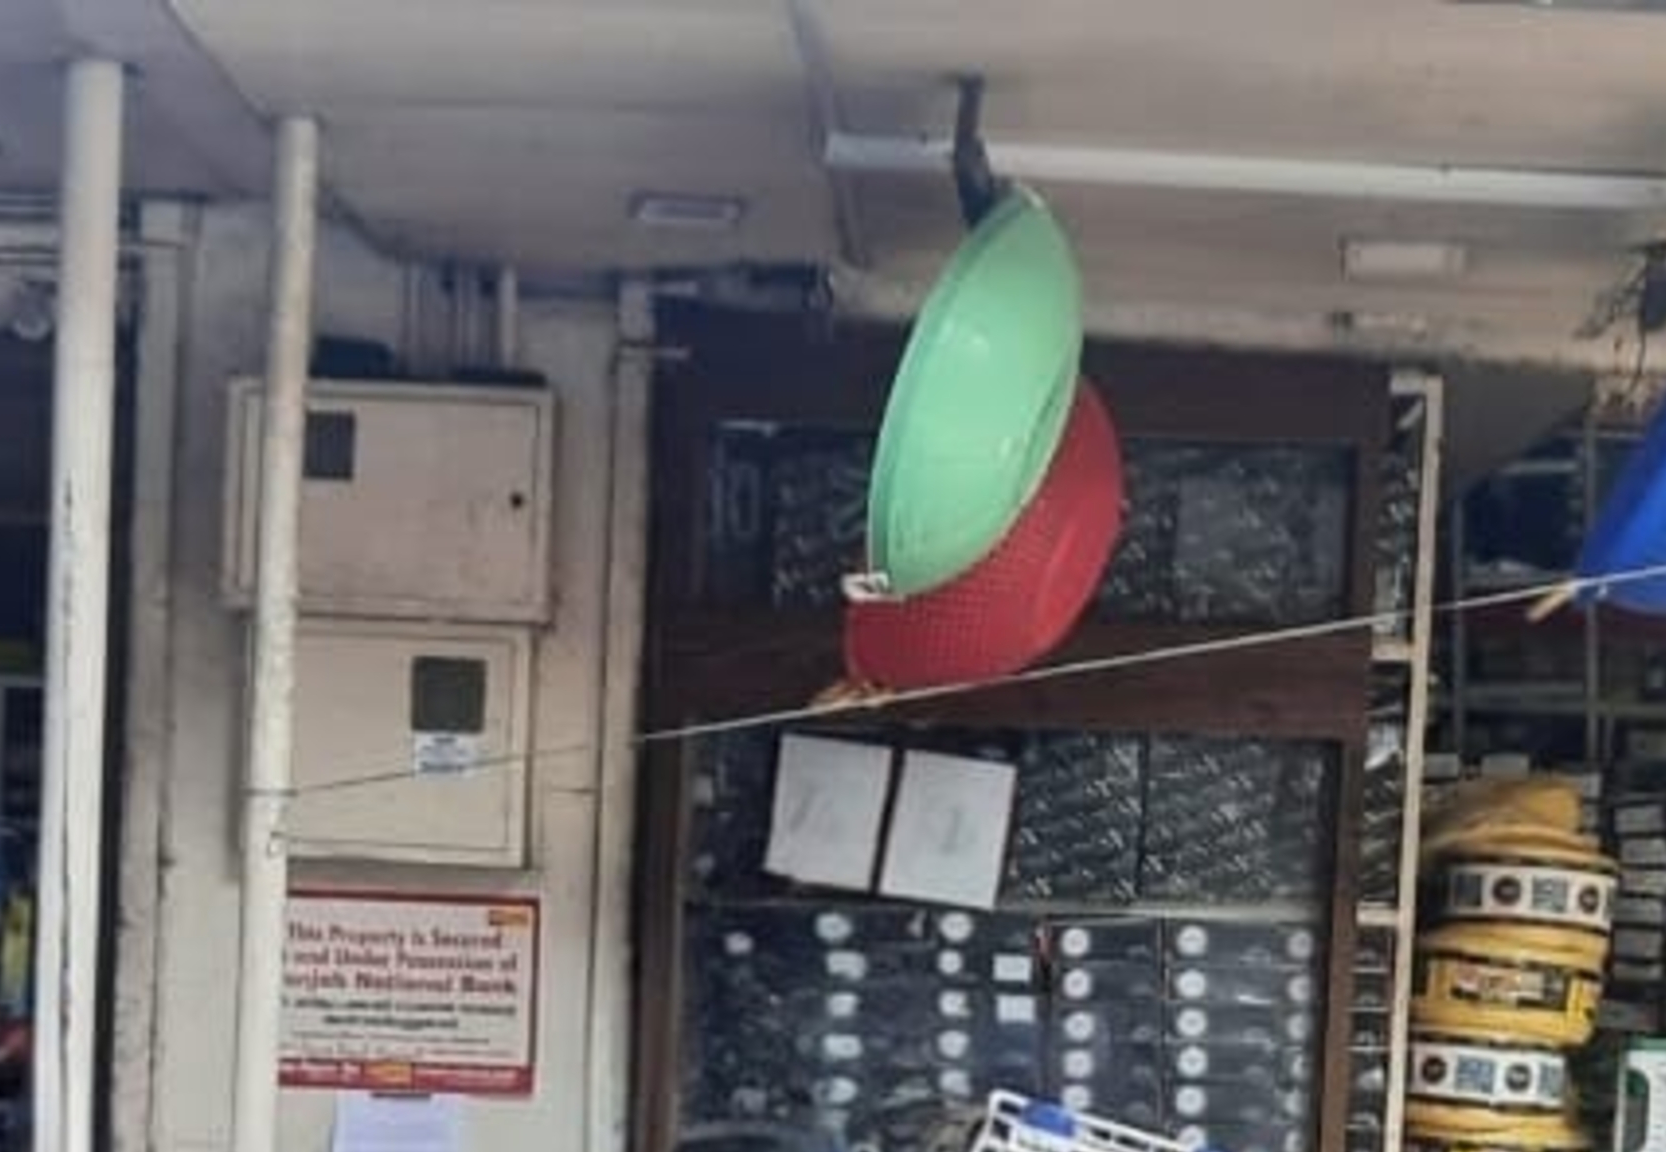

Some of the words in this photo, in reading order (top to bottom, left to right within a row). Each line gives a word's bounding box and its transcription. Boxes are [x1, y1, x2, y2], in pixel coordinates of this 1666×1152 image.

[329, 924, 405, 948] Property
[432, 926, 502, 951] Secured
[335, 947, 388, 968] Under
[396, 949, 494, 971] Possession
[355, 970, 452, 993] National
[460, 975, 517, 995] Bank
